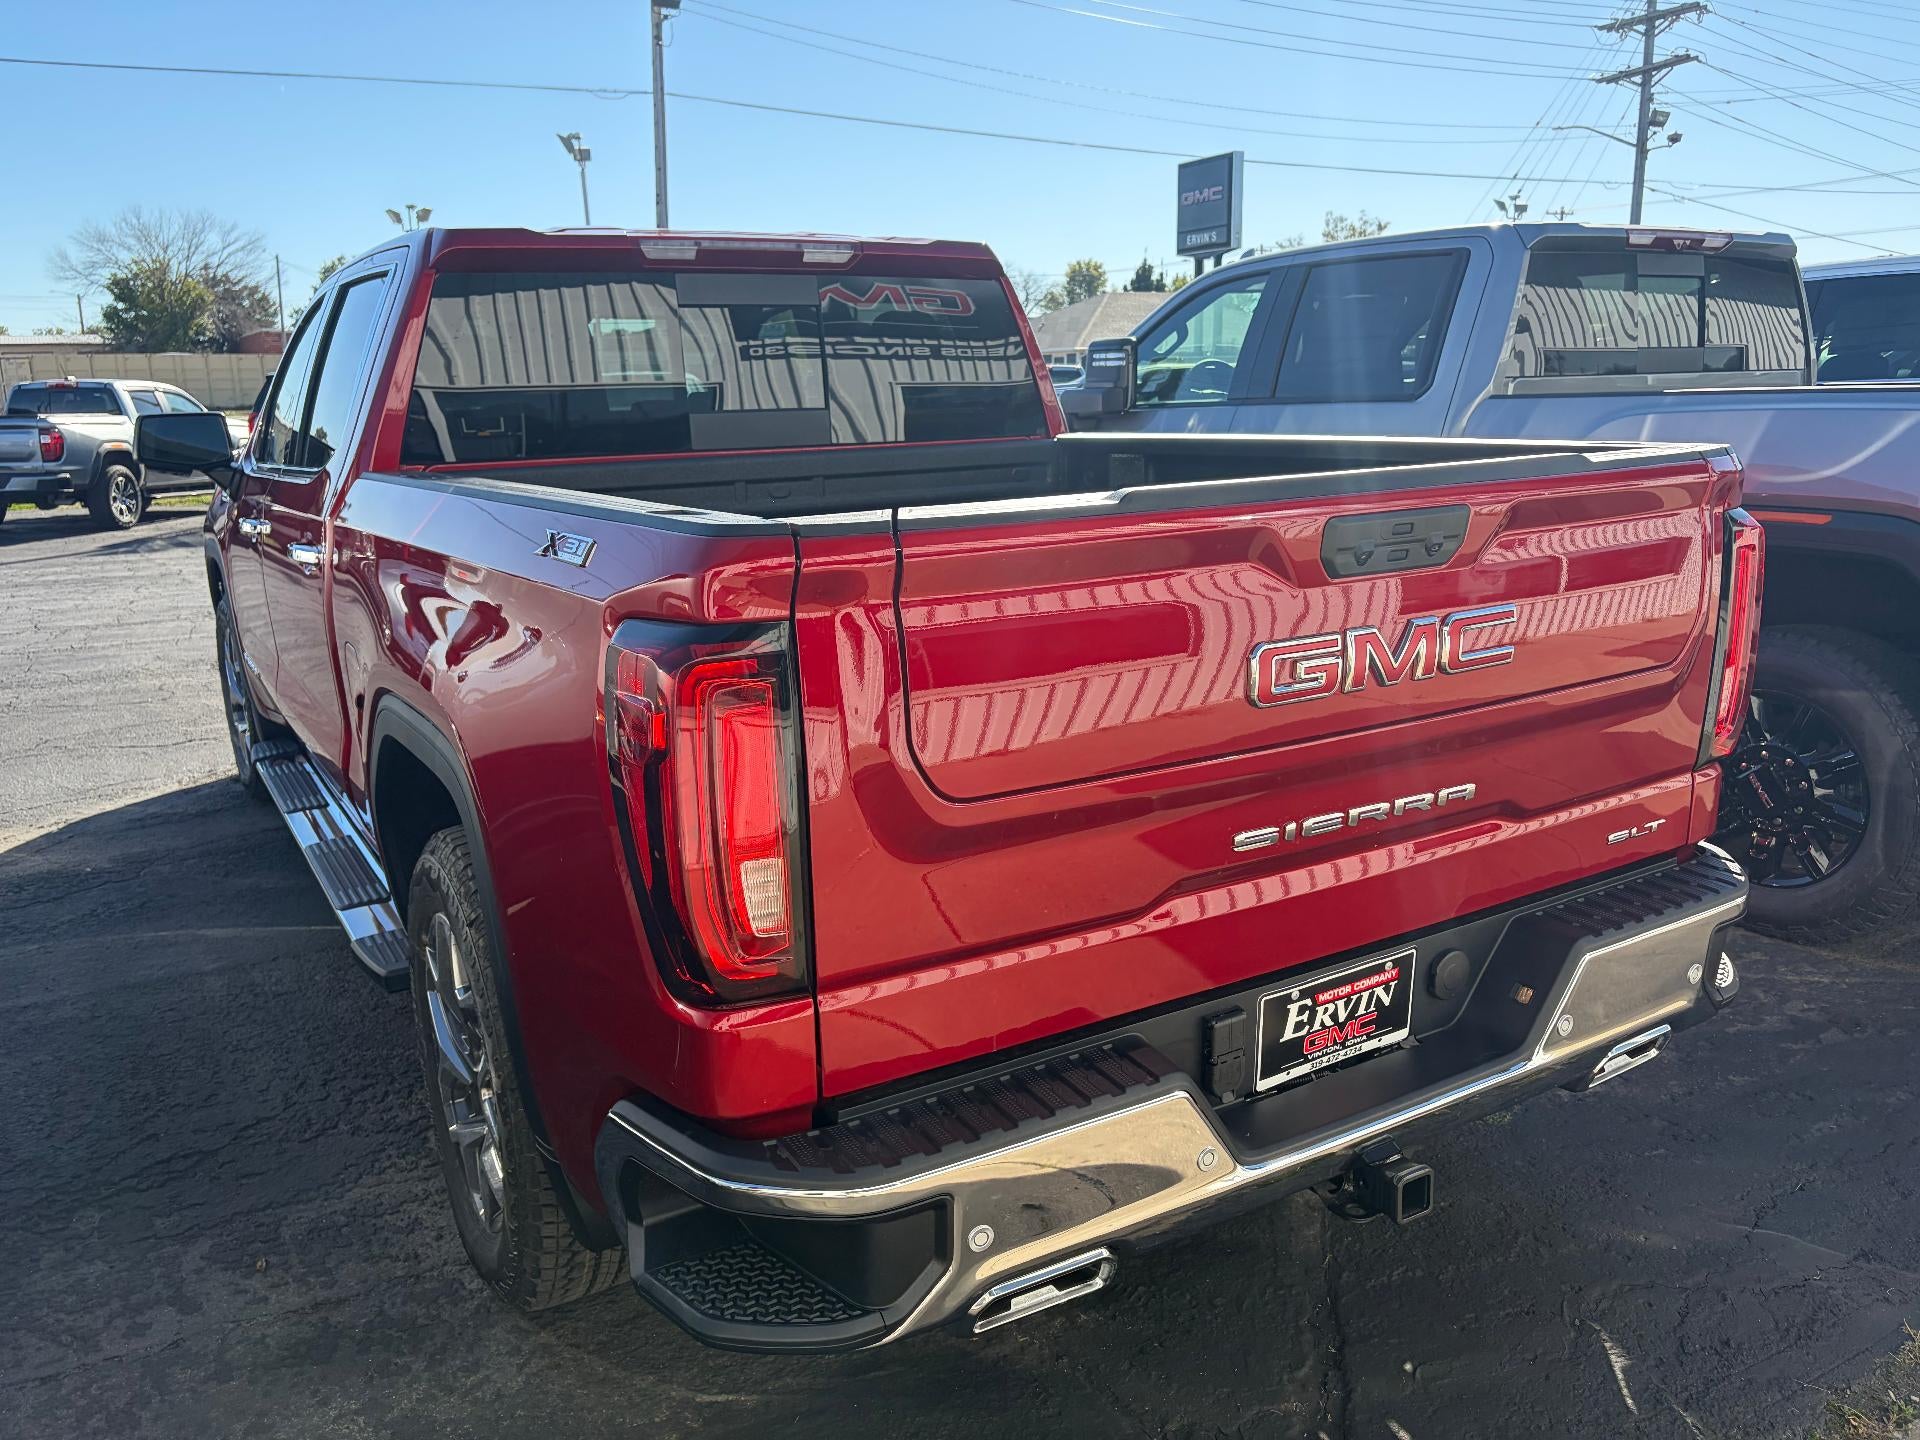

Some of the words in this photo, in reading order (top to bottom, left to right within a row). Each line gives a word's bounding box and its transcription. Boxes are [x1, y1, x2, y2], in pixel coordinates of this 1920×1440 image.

[1182, 185, 1223, 206] GMC
[1186, 231, 1217, 246] ERVIN'S
[534, 529, 592, 562] X31
[1246, 603, 1516, 709] GMC
[1232, 783, 1476, 852] SIERRA
[1607, 818, 1666, 846] SLT
[1318, 985, 1353, 1003] MOTOR
[1353, 969, 1398, 992] COMPANY
[1279, 980, 1398, 1043] ERVIN
[1303, 1011, 1378, 1055] GMC
[1307, 1044, 1343, 1060] VINTON,
[1345, 1034, 1368, 1047] IOWA
